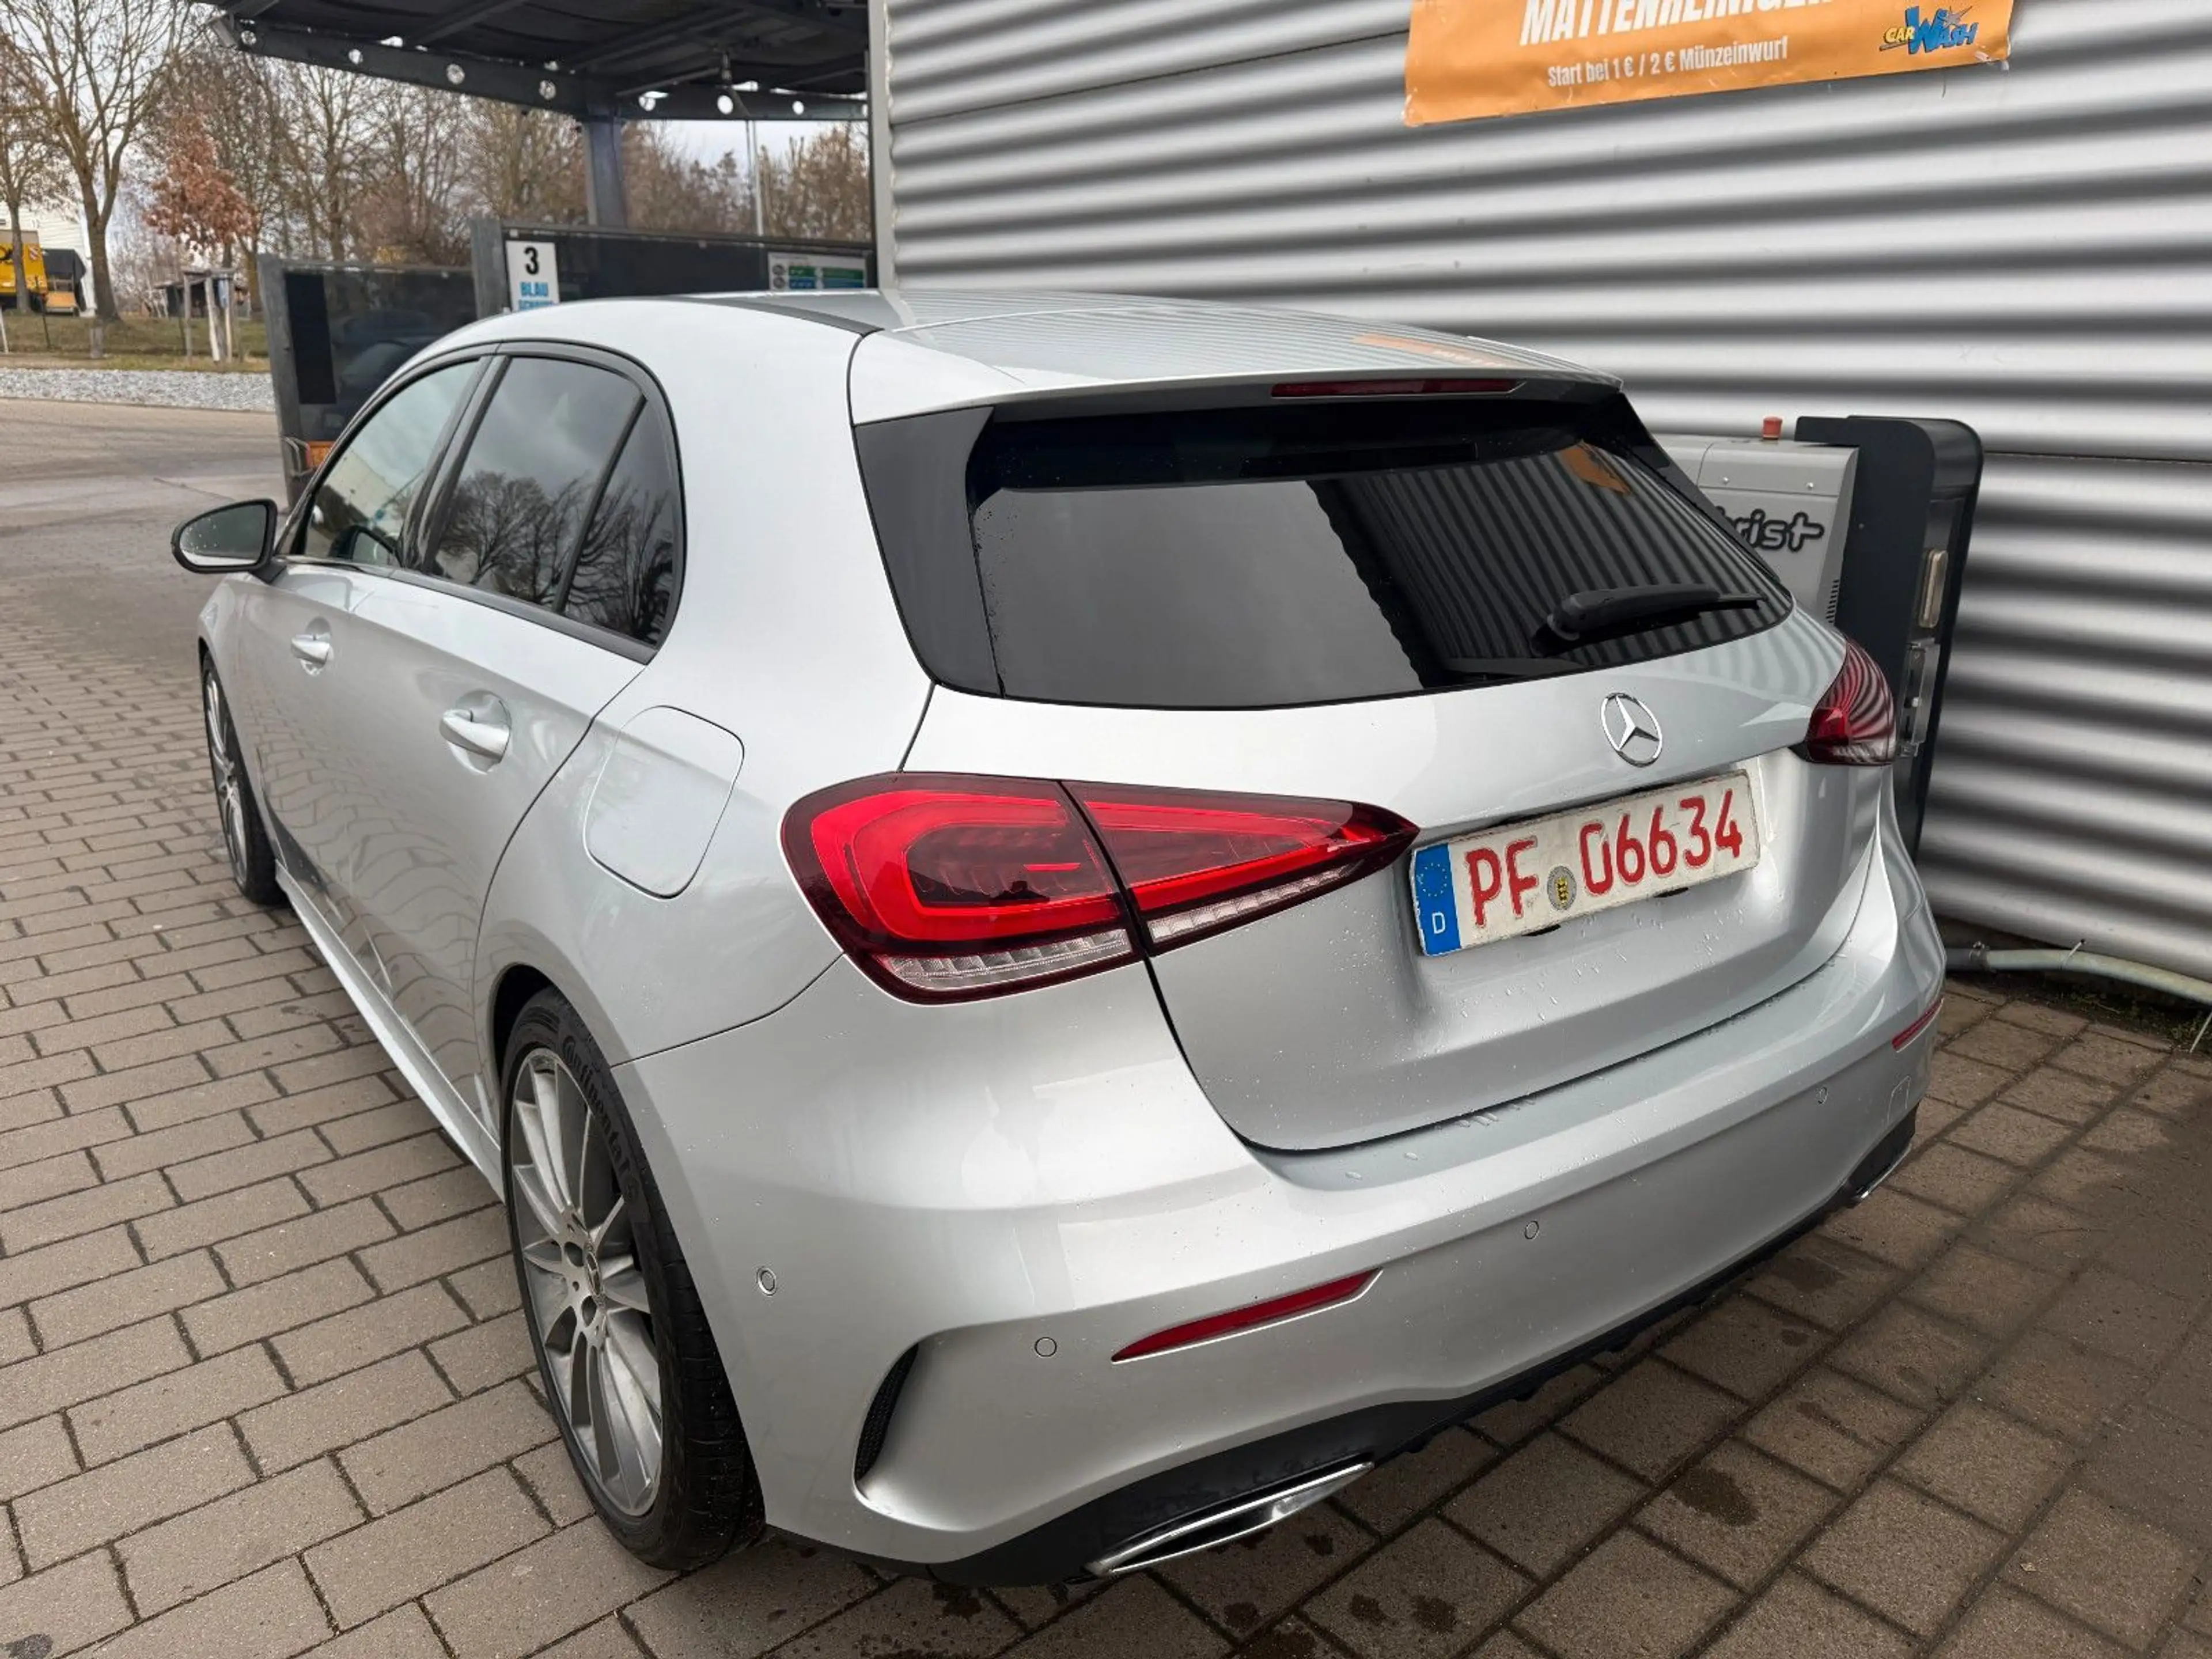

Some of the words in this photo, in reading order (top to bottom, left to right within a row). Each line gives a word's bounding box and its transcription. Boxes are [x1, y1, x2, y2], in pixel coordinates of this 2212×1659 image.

[1884, 26, 1915, 44] CAR
[1548, 63, 1582, 86] Start
[1586, 59, 1609, 82] bei
[1679, 35, 1788, 71] Münzeinwurf
[524, 245, 539, 275] 3
[1716, 506, 1825, 552] rist
[1465, 835, 1539, 927] PF
[1580, 788, 1743, 896] 06634
[1432, 912, 1445, 934] D
